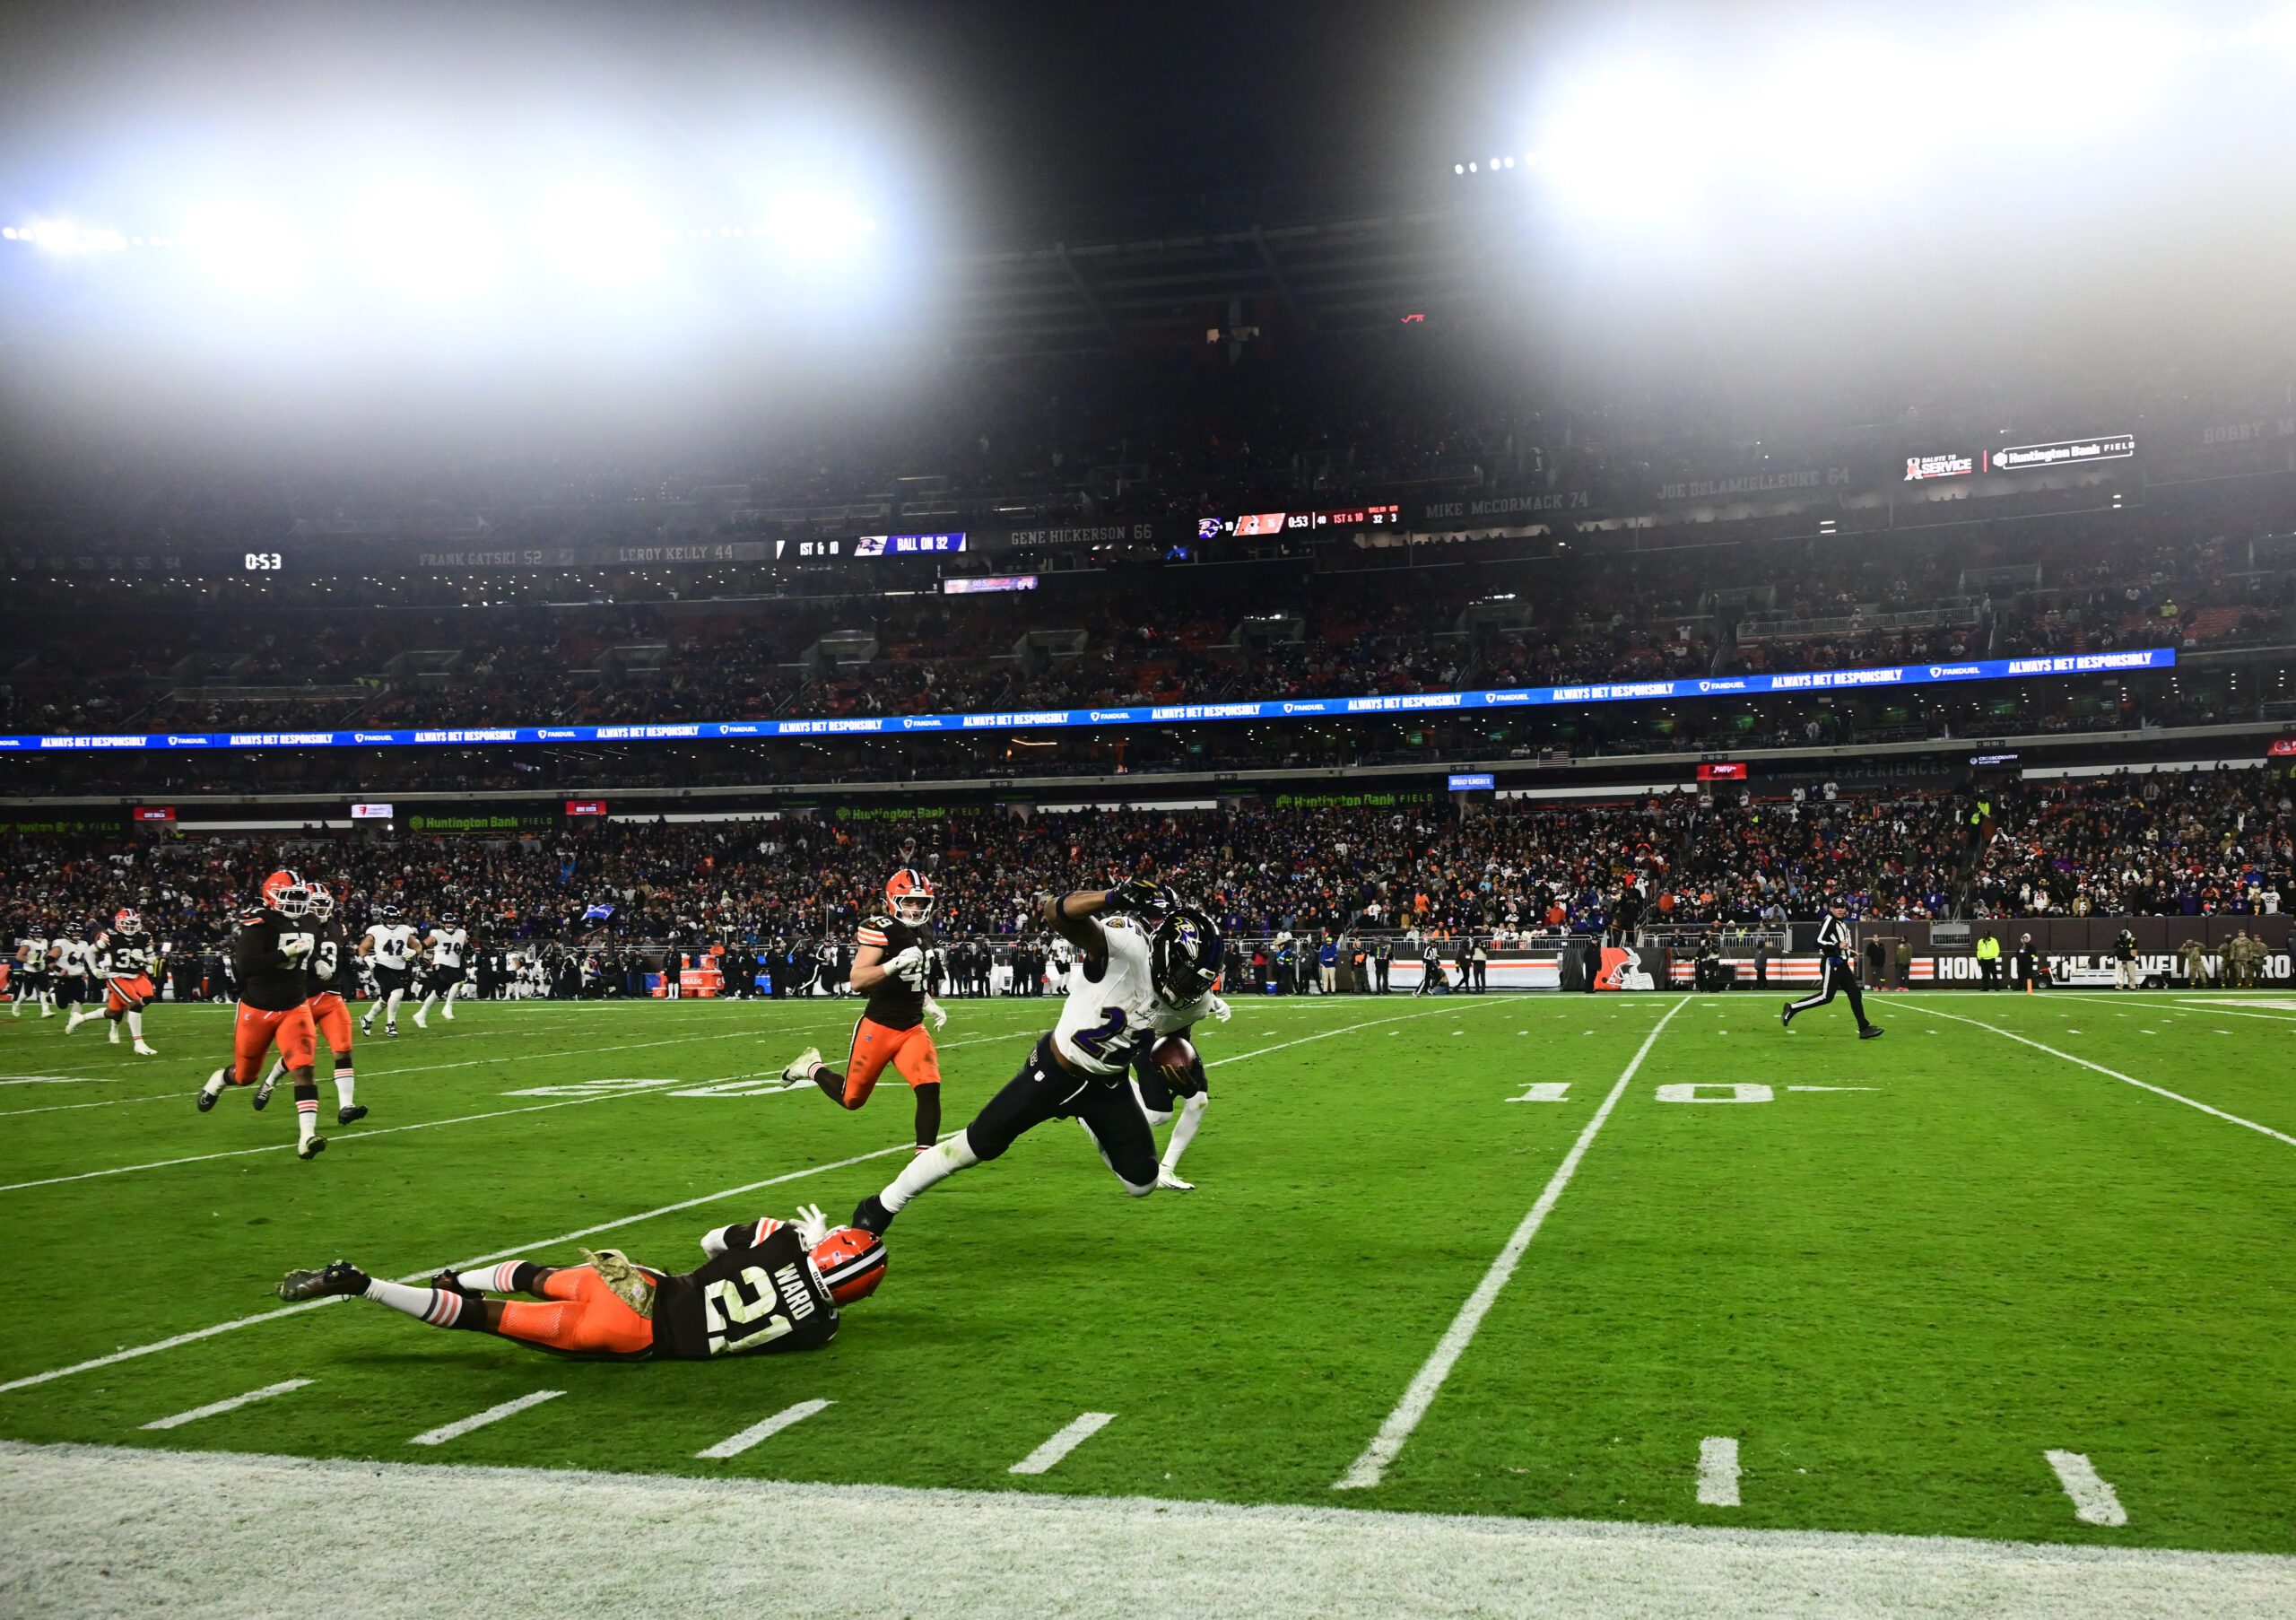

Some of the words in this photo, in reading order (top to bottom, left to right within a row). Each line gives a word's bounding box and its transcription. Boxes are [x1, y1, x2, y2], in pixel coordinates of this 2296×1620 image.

[1921, 455, 1947, 464] SALUTE
[2008, 448, 2070, 464] Huntington
[2071, 444, 2100, 457] Bank
[2103, 442, 2135, 451] FIELD
[1921, 458, 1972, 474] SERVICE
[1657, 483, 1686, 500] JOE
[1828, 467, 1850, 485] 64
[1426, 502, 1463, 518] MIKE
[1570, 492, 1589, 508] 74
[1288, 516, 1309, 528] 0:53
[1334, 514, 1346, 524] 1ST
[1355, 512, 1363, 522] 10
[1372, 515, 1383, 524] 32
[1391, 513, 1396, 522] 3
[1224, 521, 1234, 531] 10
[1012, 532, 1047, 545] GENE
[1050, 527, 1126, 544] HICKERSON
[1134, 525, 1152, 539] 66
[817, 542, 824, 555] &
[897, 537, 918, 552] BALL
[921, 537, 934, 551] ON
[936, 536, 948, 550] 32
[419, 553, 465, 566] FRANK
[467, 552, 516, 565] GATSKI
[523, 550, 542, 564] 52
[620, 548, 661, 562] LEROY
[666, 546, 708, 561] KELLY
[715, 545, 733, 559] 44
[245, 553, 282, 570] 0:53
[1943, 666, 1979, 675] FANDUEL
[2009, 658, 2053, 674] ALWAYS
[2055, 658, 2074, 671] BET
[2078, 652, 2152, 669] RESPONSIBLY
[1711, 681, 1745, 690] FANDUEL
[1772, 675, 1813, 689] ALWAYS
[1814, 673, 1832, 686] BET
[1835, 669, 1902, 684] RESPONSIBLY
[1497, 693, 1528, 701] FANDUEL
[1553, 687, 1590, 701] ALWAYS
[1592, 686, 1609, 699] BET
[1612, 683, 1674, 698] RESPONSIBLY
[1294, 703, 1325, 711] FANDUEL
[1348, 698, 1383, 710] ALWAYS
[1385, 697, 1400, 710] BET
[1403, 694, 1461, 708] RESPONSIBLY
[1152, 707, 1186, 719] ALWAYS
[1187, 707, 1202, 719] BET
[1205, 704, 1260, 718] RESPONSIBLY
[779, 721, 811, 733] ALWAYS
[813, 721, 827, 732] BET
[829, 719, 882, 732] RESPONSIBLY
[963, 715, 996, 727] ALWAYS
[997, 714, 1012, 726] BET
[1013, 712, 1068, 725] RESPONSIBLY
[230, 735, 262, 745] ALWAYS
[264, 735, 278, 745] BET
[280, 734, 333, 745] RESPONSIBLY
[415, 731, 447, 743] ALWAYS
[448, 731, 462, 742] BET
[464, 730, 517, 741] RESPONSIBLY
[597, 727, 629, 738] ALWAYS
[630, 727, 644, 737] BET
[646, 726, 699, 737] RESPONSIBLY
[41, 737, 74, 747] ALWAYS
[75, 736, 90, 747] BET
[91, 736, 146, 747] RESPONSIBLY
[1834, 762, 1950, 780] EXPERIENCES
[1400, 794, 1433, 804] FIELD
[951, 807, 980, 816] FELD
[426, 817, 489, 831] Huntington
[490, 816, 518, 828] Bank
[524, 817, 553, 826] FIELD
[383, 939, 404, 956] 42
[443, 942, 461, 955] 70
[774, 1262, 815, 1320] WARD
[704, 1266, 794, 1354] 21
